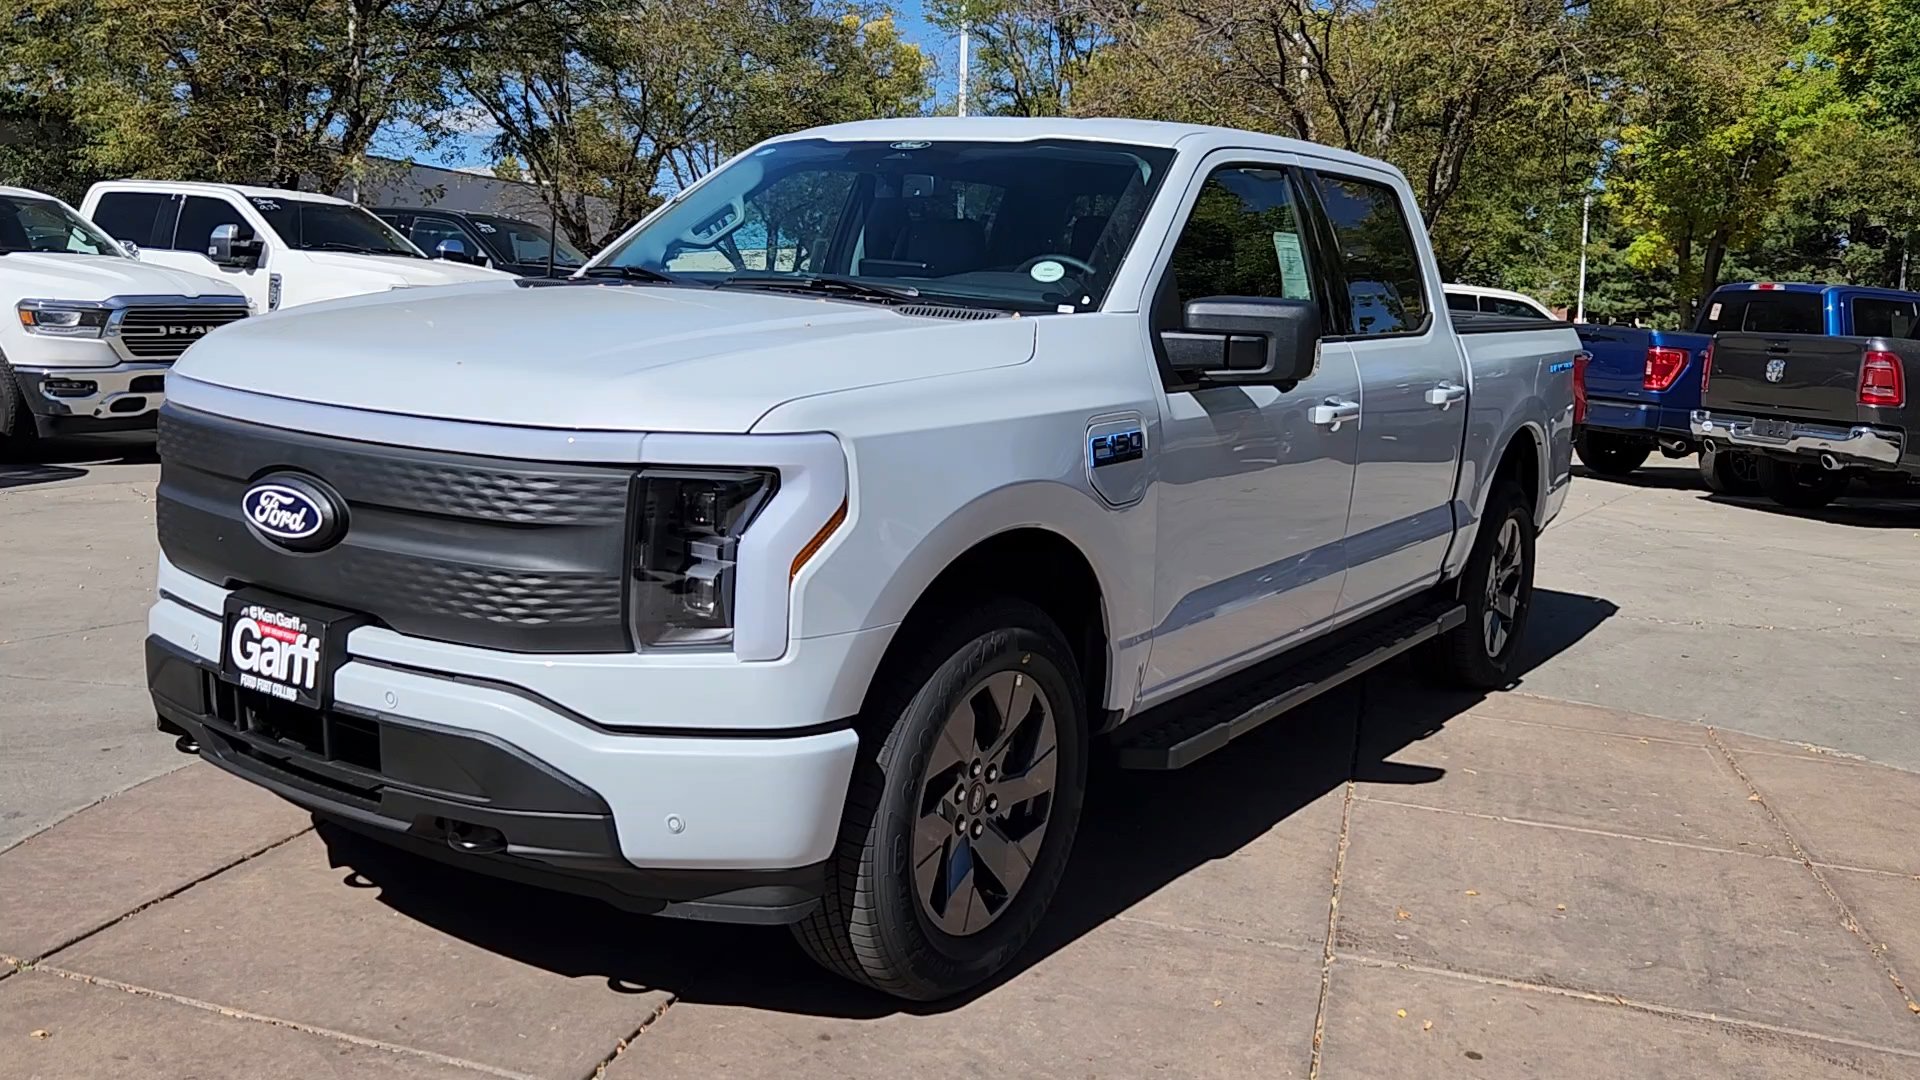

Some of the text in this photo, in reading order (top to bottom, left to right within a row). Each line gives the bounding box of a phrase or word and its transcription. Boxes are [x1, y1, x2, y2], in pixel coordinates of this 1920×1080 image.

[254, 491, 307, 531] Ford
[257, 606, 299, 630] Ken Garff
[231, 617, 319, 689] Garff
